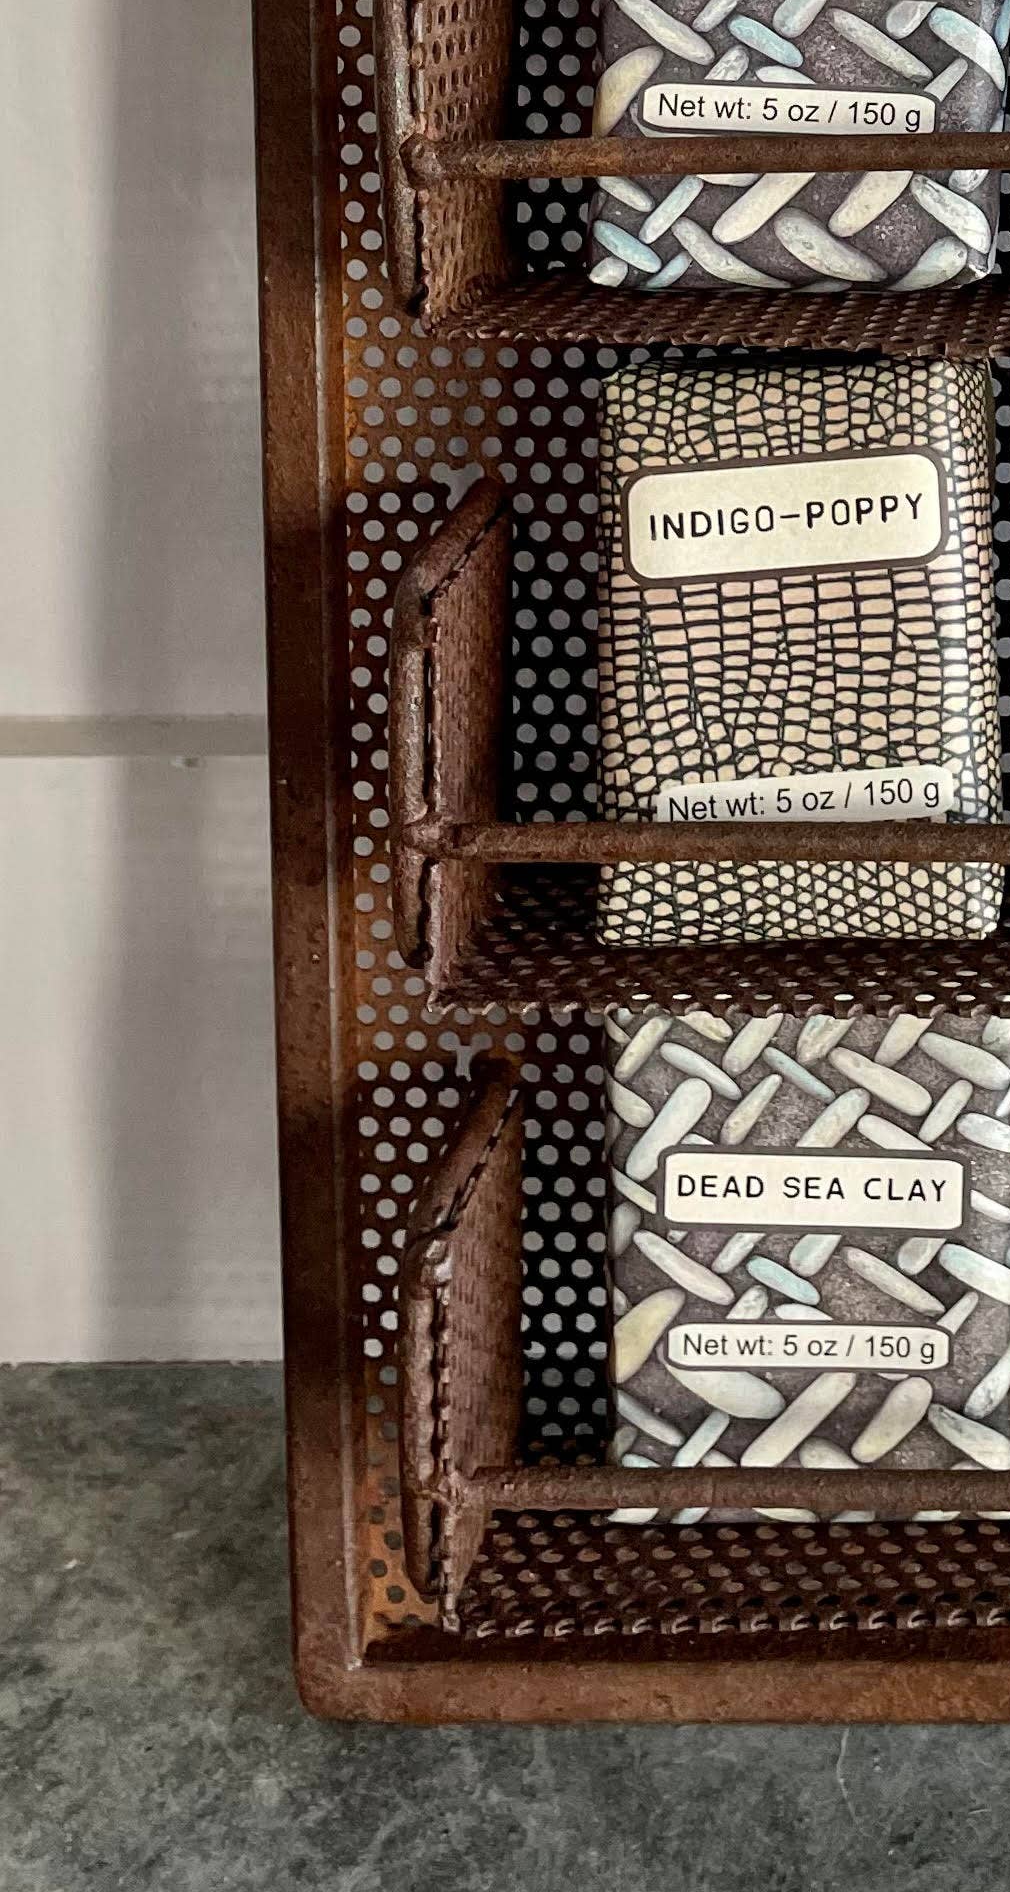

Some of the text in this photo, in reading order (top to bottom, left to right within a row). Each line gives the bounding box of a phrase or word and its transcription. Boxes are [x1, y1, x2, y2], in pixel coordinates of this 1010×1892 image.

[658, 92, 921, 132] Net wt: 5 oz / 150 g
[649, 492, 923, 542] INDIGO-POPPY
[668, 778, 939, 822] Net wt: 5 oz / 150 g
[677, 1174, 947, 1203] DEAD SEA CLAY
[682, 1332, 936, 1365] Net wt: 5 oz / 150 g
